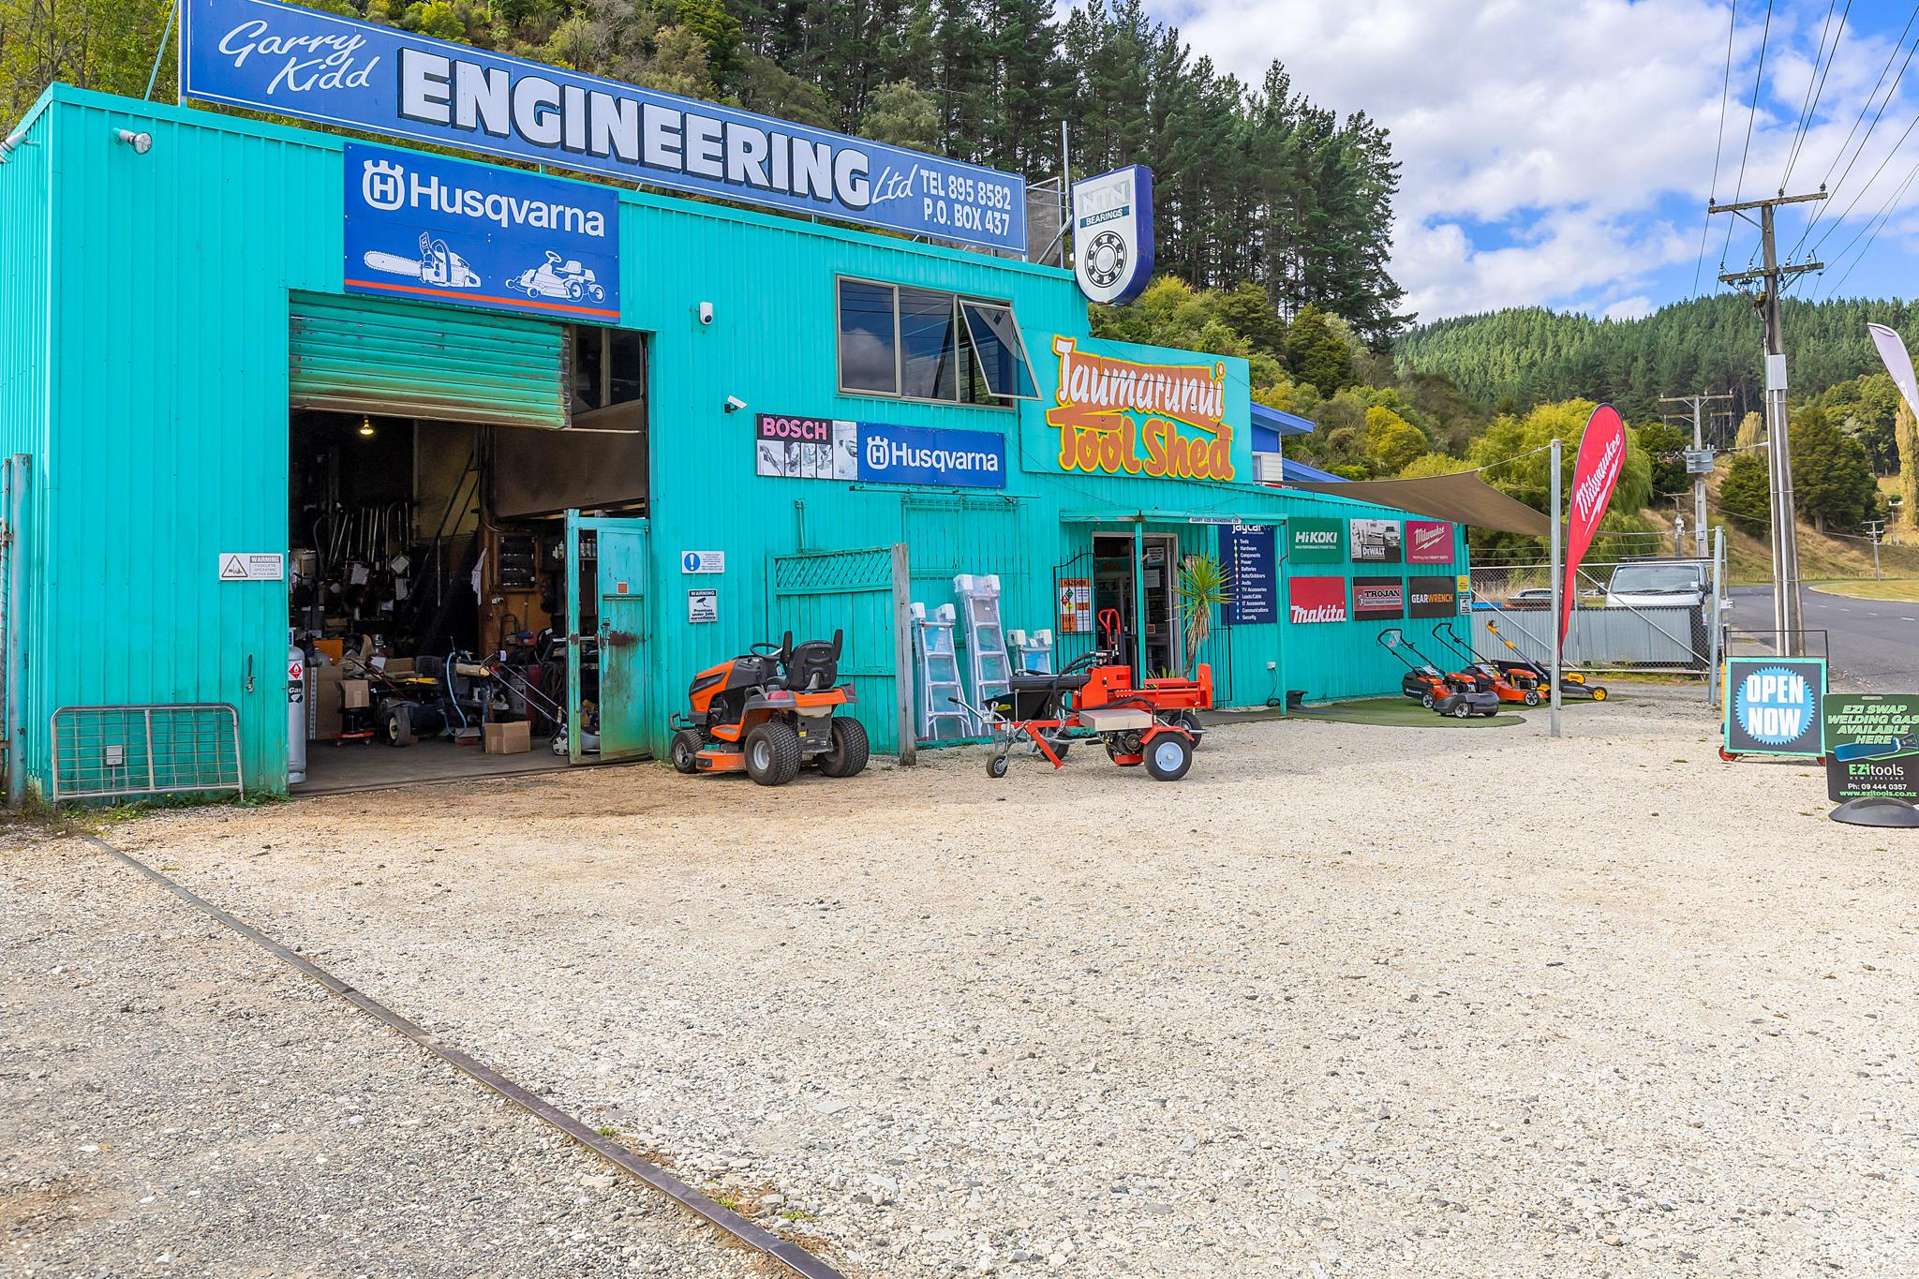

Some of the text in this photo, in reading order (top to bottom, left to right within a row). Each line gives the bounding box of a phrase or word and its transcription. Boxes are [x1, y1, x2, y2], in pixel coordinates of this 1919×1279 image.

[218, 20, 367, 67] Garry
[266, 56, 381, 95] Kidd
[399, 47, 870, 208] ENGINEERING
[871, 163, 918, 204] Ltd
[920, 169, 1011, 210] TEL 895 8582
[410, 173, 605, 237] Husqvarna
[924, 198, 1010, 236] P.O. BOX 437
[1086, 208, 1123, 226] BEARINGS
[1055, 338, 1223, 417] Taumarunui
[762, 417, 827, 441] BOSCH
[1048, 407, 1235, 480] Tool Shed
[891, 442, 998, 473] Husqvarna
[1575, 430, 1620, 521] Milwaukee
[1295, 531, 1338, 543] HiKOKI
[1365, 590, 1400, 598] TROJAN
[1411, 594, 1454, 603] GEARWRENCH
[1746, 675, 1804, 704] OPEN
[1747, 707, 1801, 737] NOW
[1828, 715, 1919, 724] WELDING GAS
[1842, 705, 1908, 714] EZI SWAP
[1837, 725, 1911, 734] AVAILABLE
[1855, 735, 1893, 745] HERE
[1848, 764, 1904, 776] EZitools
